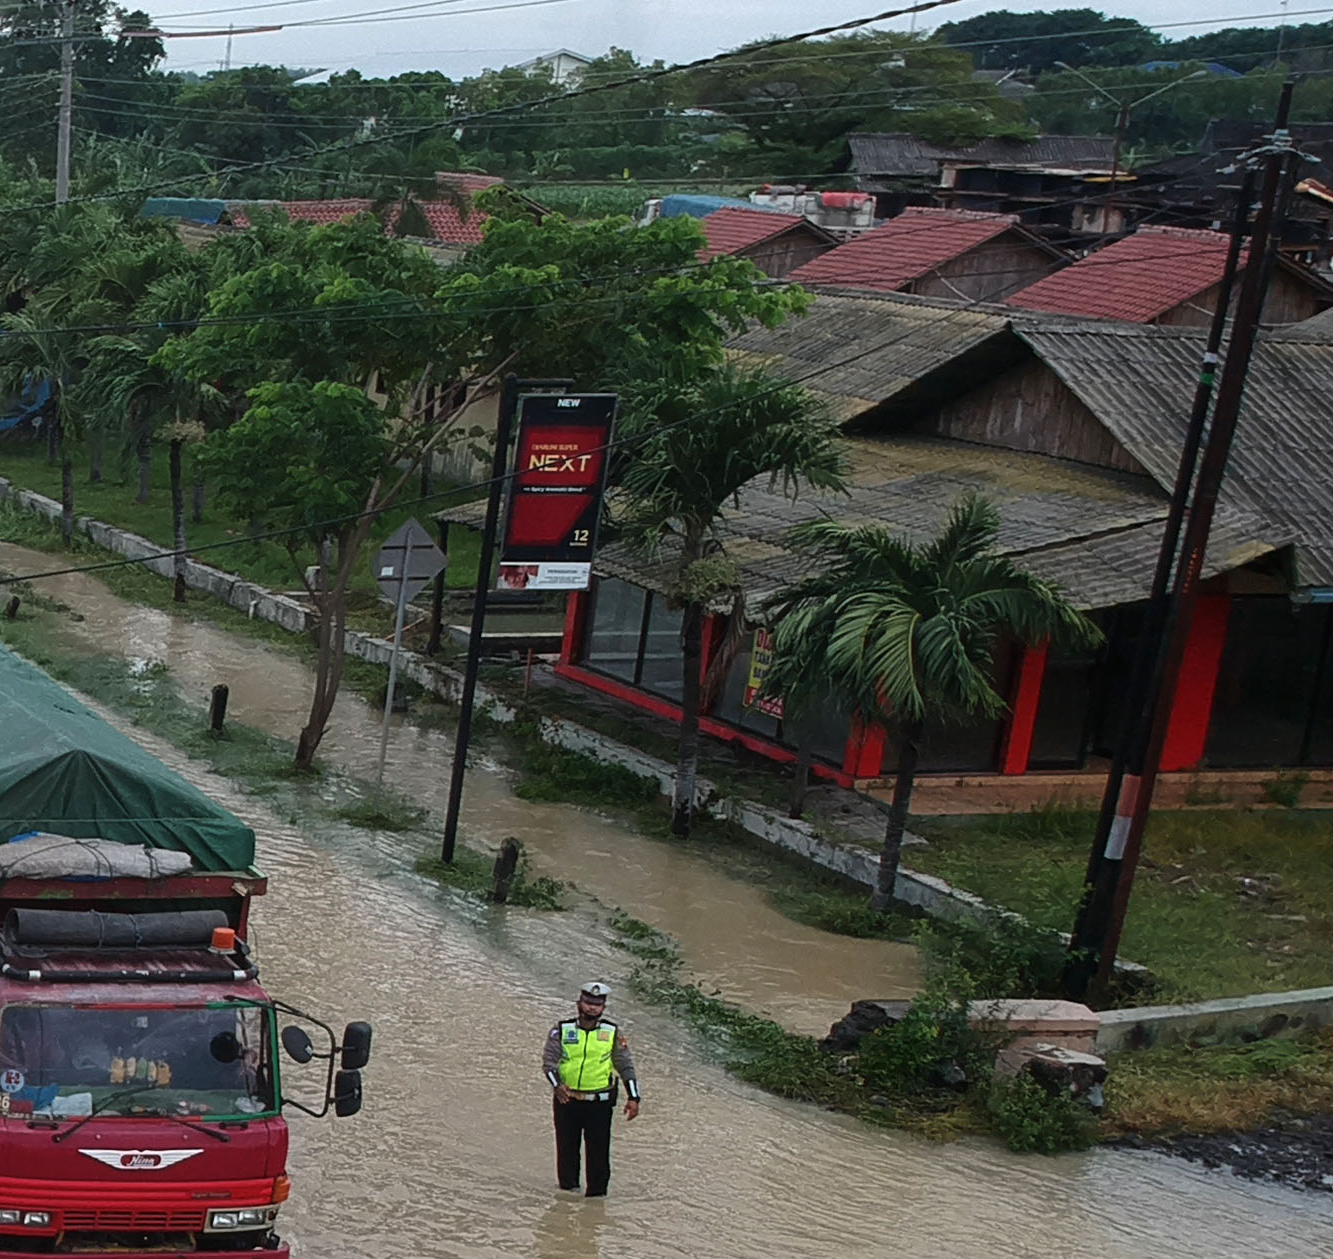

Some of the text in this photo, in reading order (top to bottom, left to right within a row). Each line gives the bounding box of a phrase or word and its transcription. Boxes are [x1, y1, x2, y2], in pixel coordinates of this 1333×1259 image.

[557, 399, 581, 407] NEW
[529, 455, 591, 472] NEXT
[573, 529, 589, 542] 12
